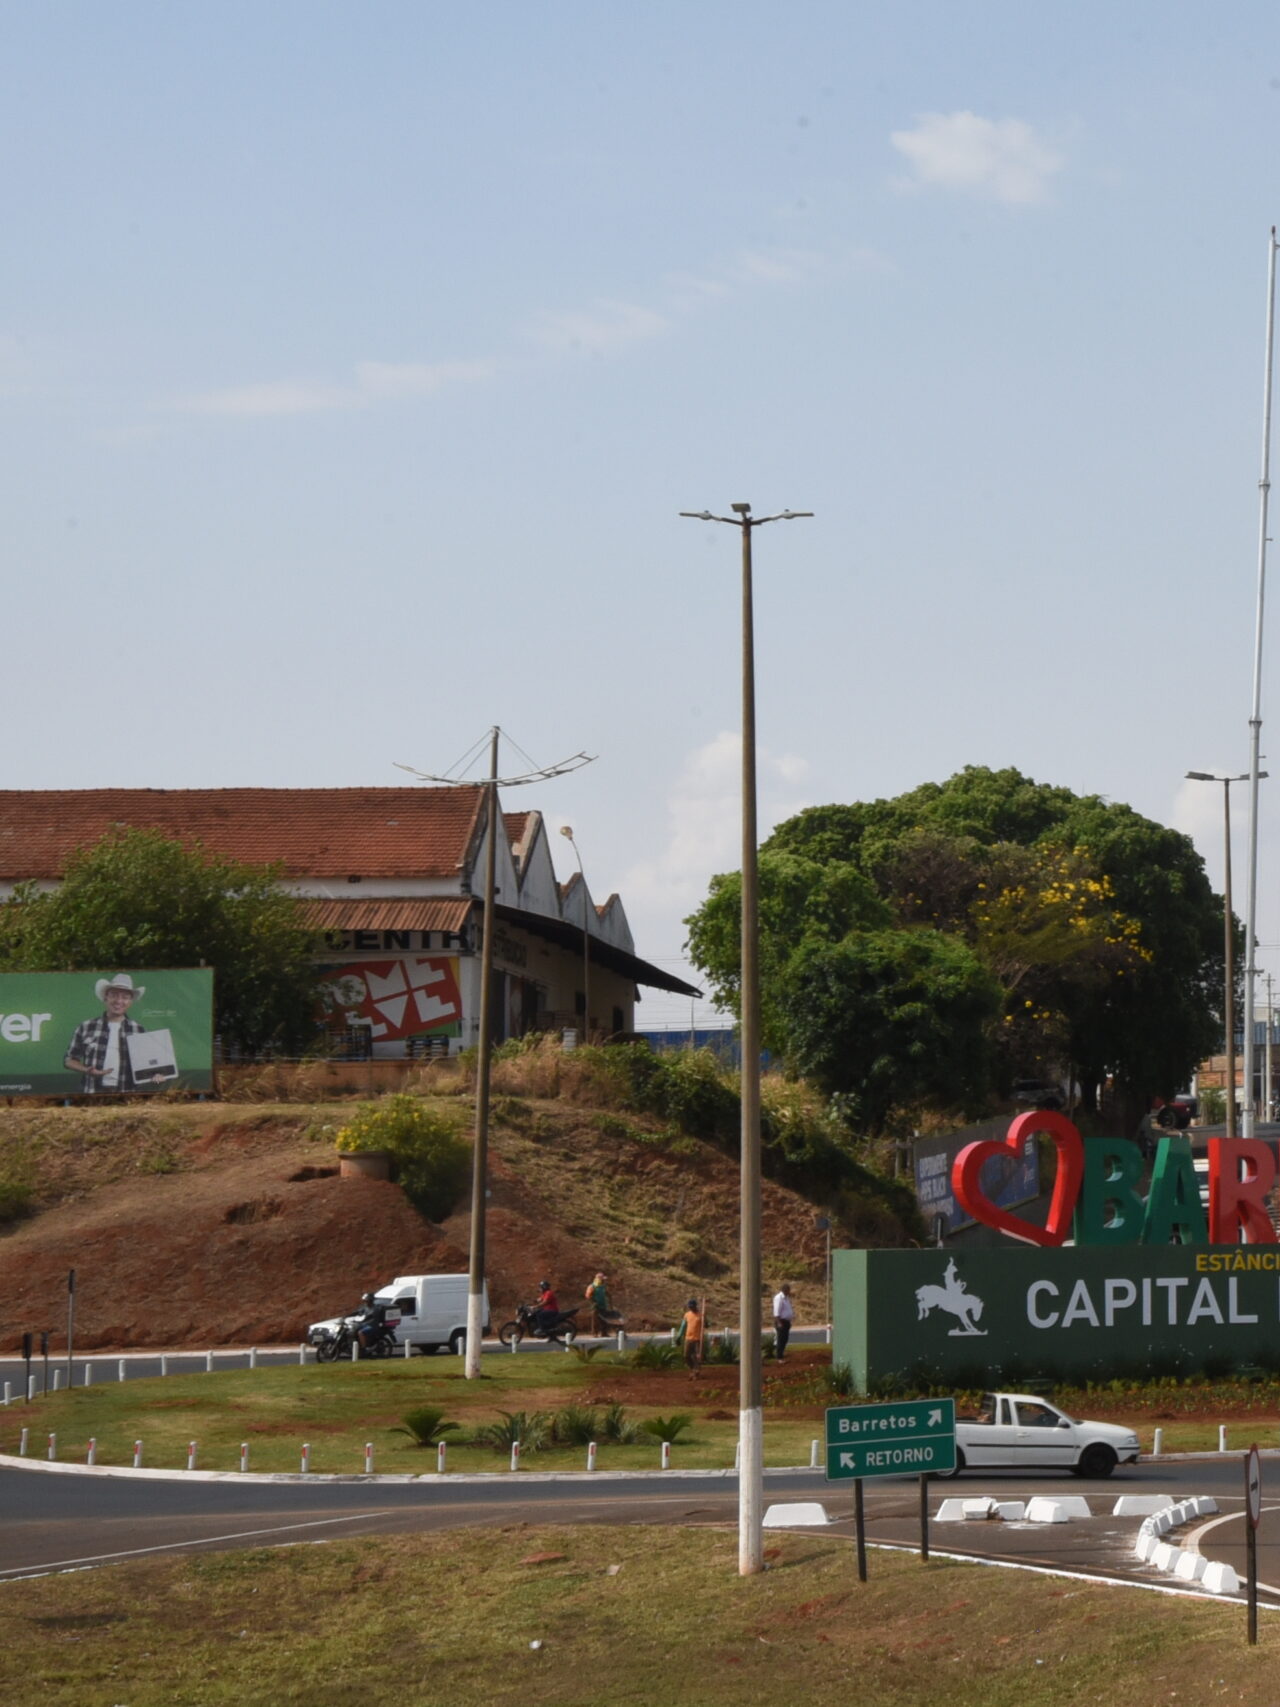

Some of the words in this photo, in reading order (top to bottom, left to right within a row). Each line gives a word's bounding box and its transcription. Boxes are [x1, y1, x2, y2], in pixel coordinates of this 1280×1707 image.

[0, 1013, 52, 1042] er
[1026, 1277, 1258, 1329] CAPITAL
[839, 1415, 917, 1433] Barretos
[866, 1447, 934, 1466] RETORNO
